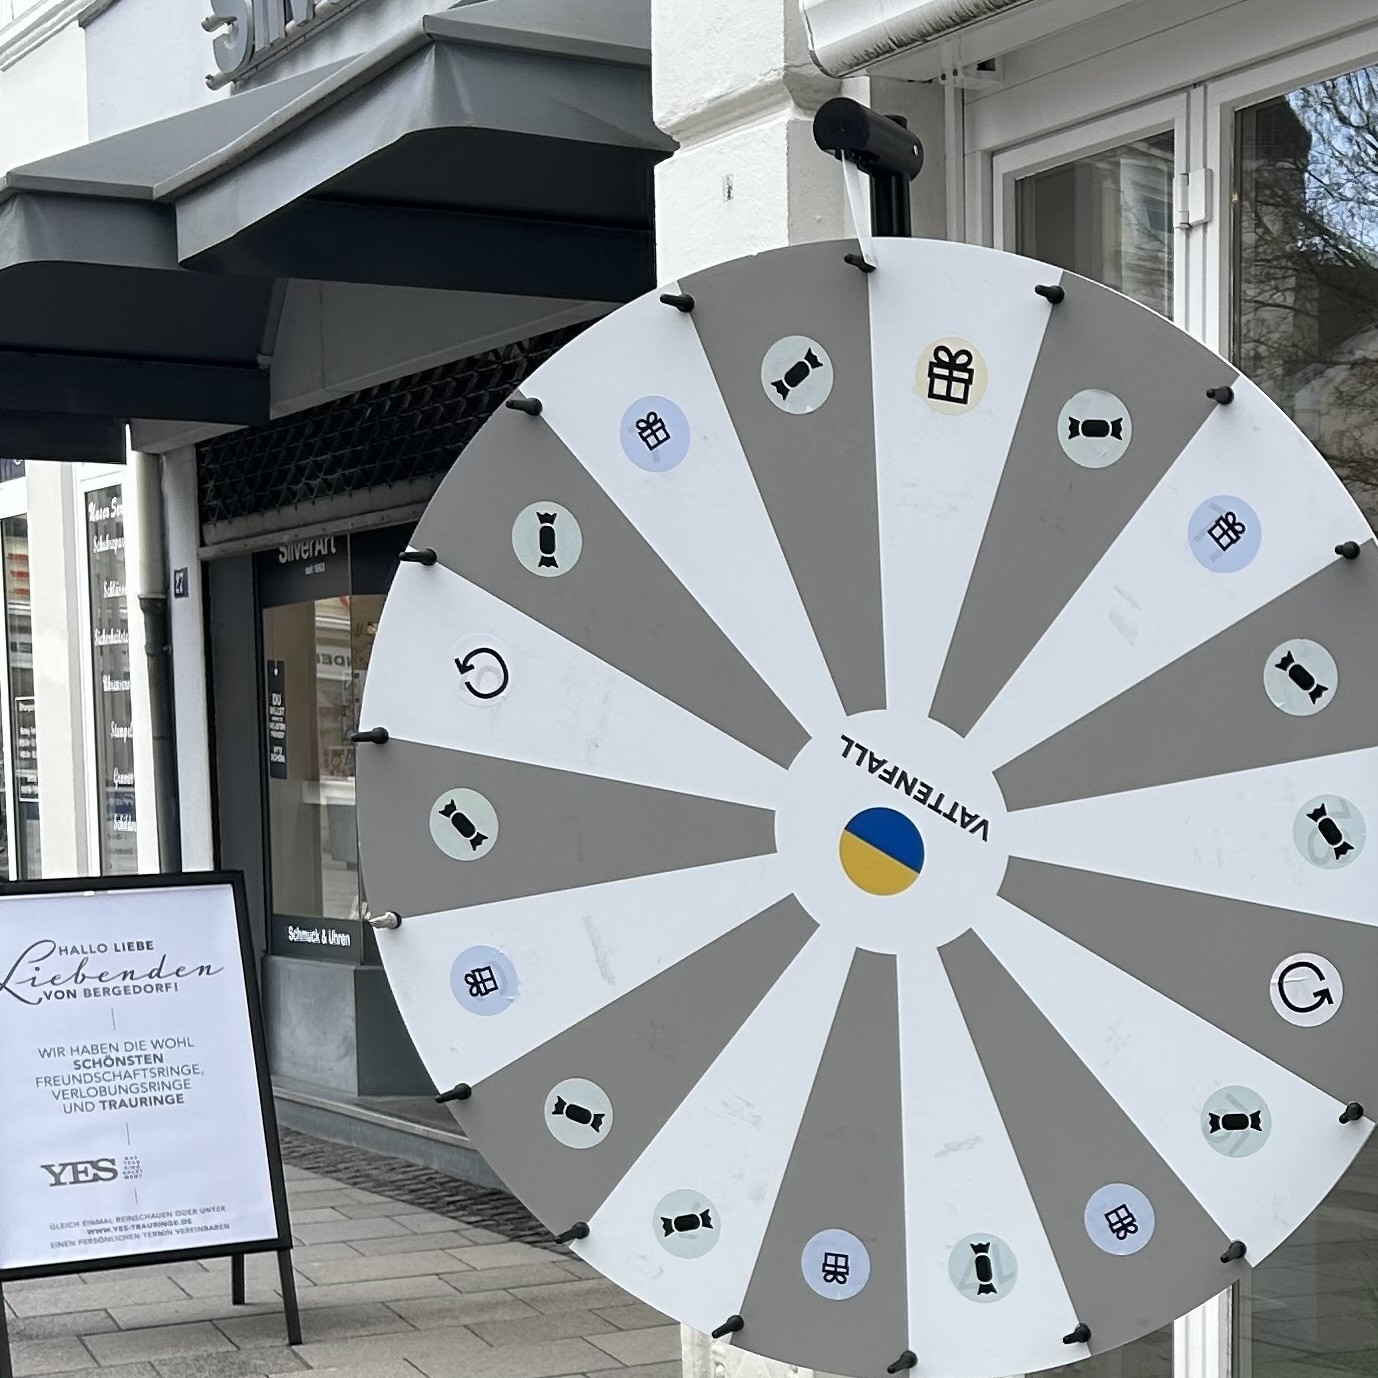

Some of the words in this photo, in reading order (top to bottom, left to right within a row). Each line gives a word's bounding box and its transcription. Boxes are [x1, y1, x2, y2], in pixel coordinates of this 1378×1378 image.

[175, 572, 184, 594] 27
[840, 734, 990, 842] VATTENFALL
[288, 925, 321, 944] Schmuck
[321, 928, 328, 944] &
[328, 928, 351, 947] Uhren
[58, 943, 108, 956] HALLO
[113, 940, 155, 953] LIEBE
[0, 939, 225, 1006] Liebenden
[43, 988, 77, 1001] VON
[38, 1045, 66, 1059] WIR
[70, 1042, 119, 1056] HABEN
[124, 1040, 147, 1052] DIE
[150, 1036, 195, 1050] WOHL
[73, 1052, 164, 1071] SCHÖNSTEN
[35, 1063, 205, 1089] FREUNDSCHAFTSRINGE,
[51, 1078, 192, 1101] VERLOBUNGSRINGE
[63, 1101, 95, 1115] UND
[99, 1093, 185, 1111] TRAURINGE
[41, 1158, 119, 1187] YES
[50, 1220, 80, 1231] GLEICH
[199, 1204, 226, 1215] UNTER
[50, 1239, 76, 1250] EINEN
